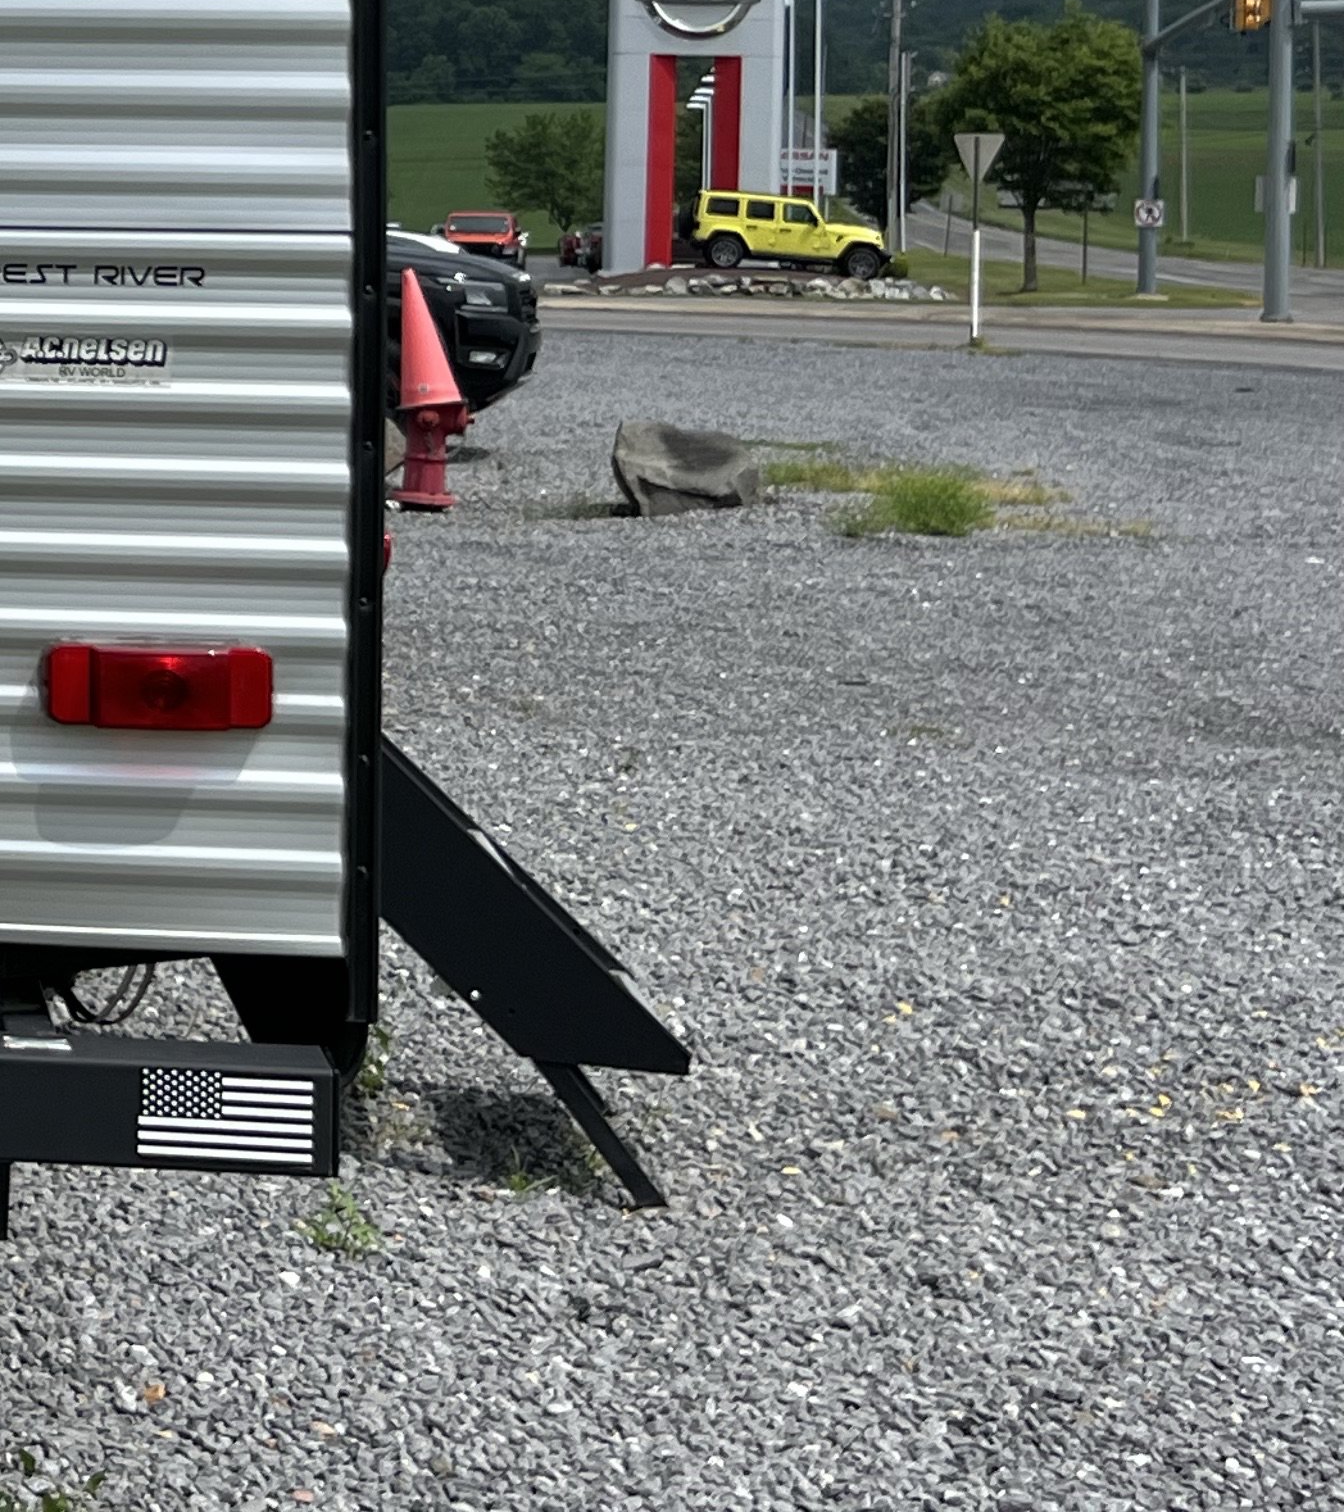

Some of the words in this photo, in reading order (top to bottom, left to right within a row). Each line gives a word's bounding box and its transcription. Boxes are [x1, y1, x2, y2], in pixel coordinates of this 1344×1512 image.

[93, 265, 207, 288] RIVER
[58, 366, 76, 377] RV
[79, 367, 127, 378] WORLD
